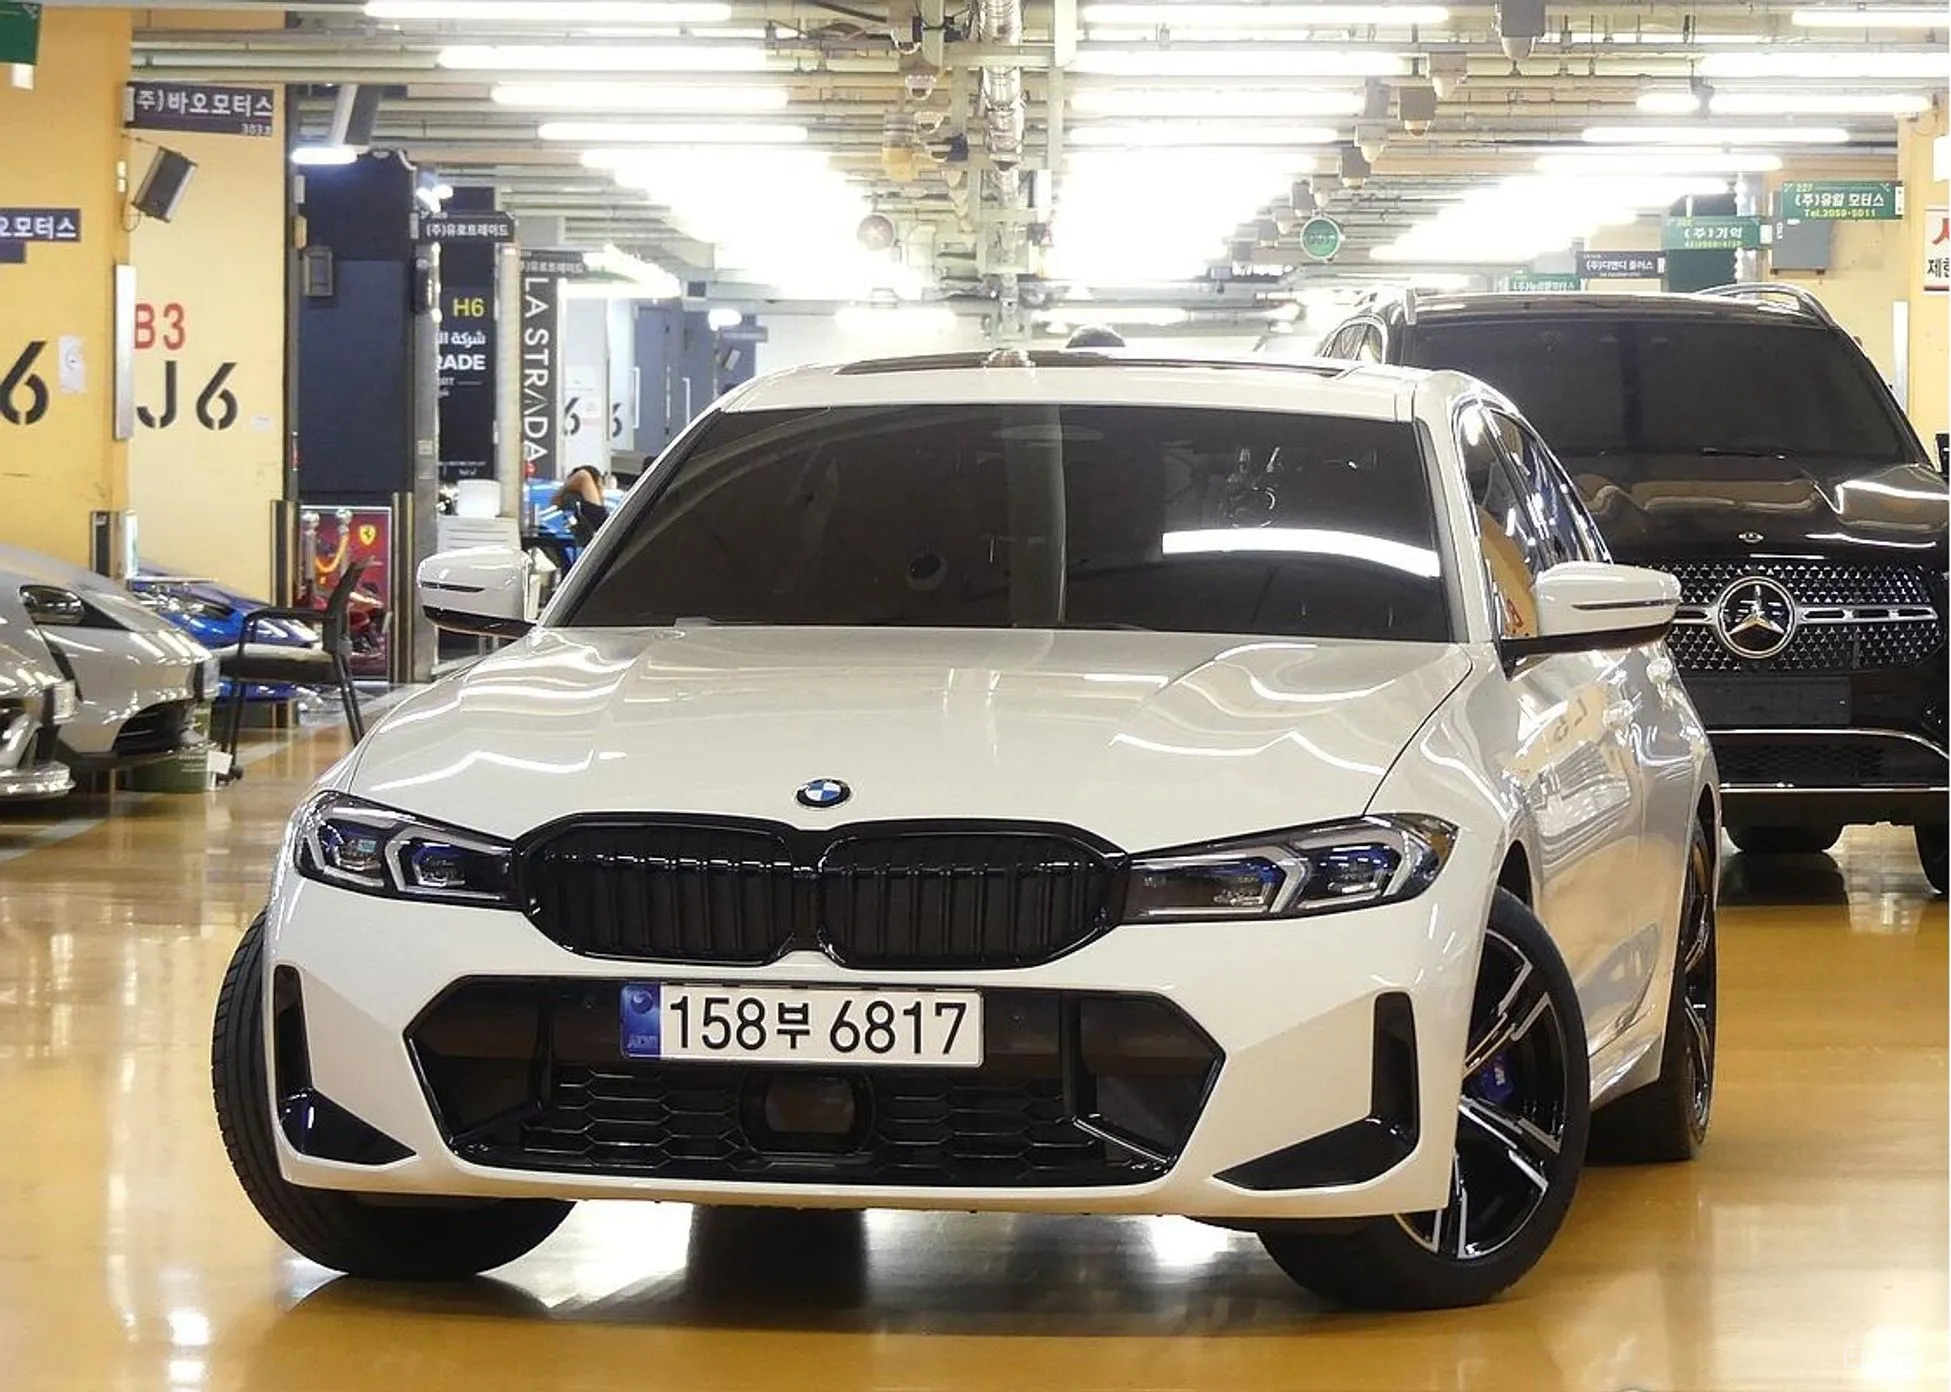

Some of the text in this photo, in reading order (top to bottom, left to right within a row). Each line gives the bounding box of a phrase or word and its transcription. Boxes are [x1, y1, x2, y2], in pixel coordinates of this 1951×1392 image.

[136, 89, 273, 117] 주)바오모터스
[426, 223, 509, 237] (주)유로트레이드
[453, 298, 485, 318] H6
[524, 277, 549, 317] LA
[135, 303, 185, 350] B3
[0, 341, 49, 426] 6
[670, 995, 967, 1055] 158부 6817
